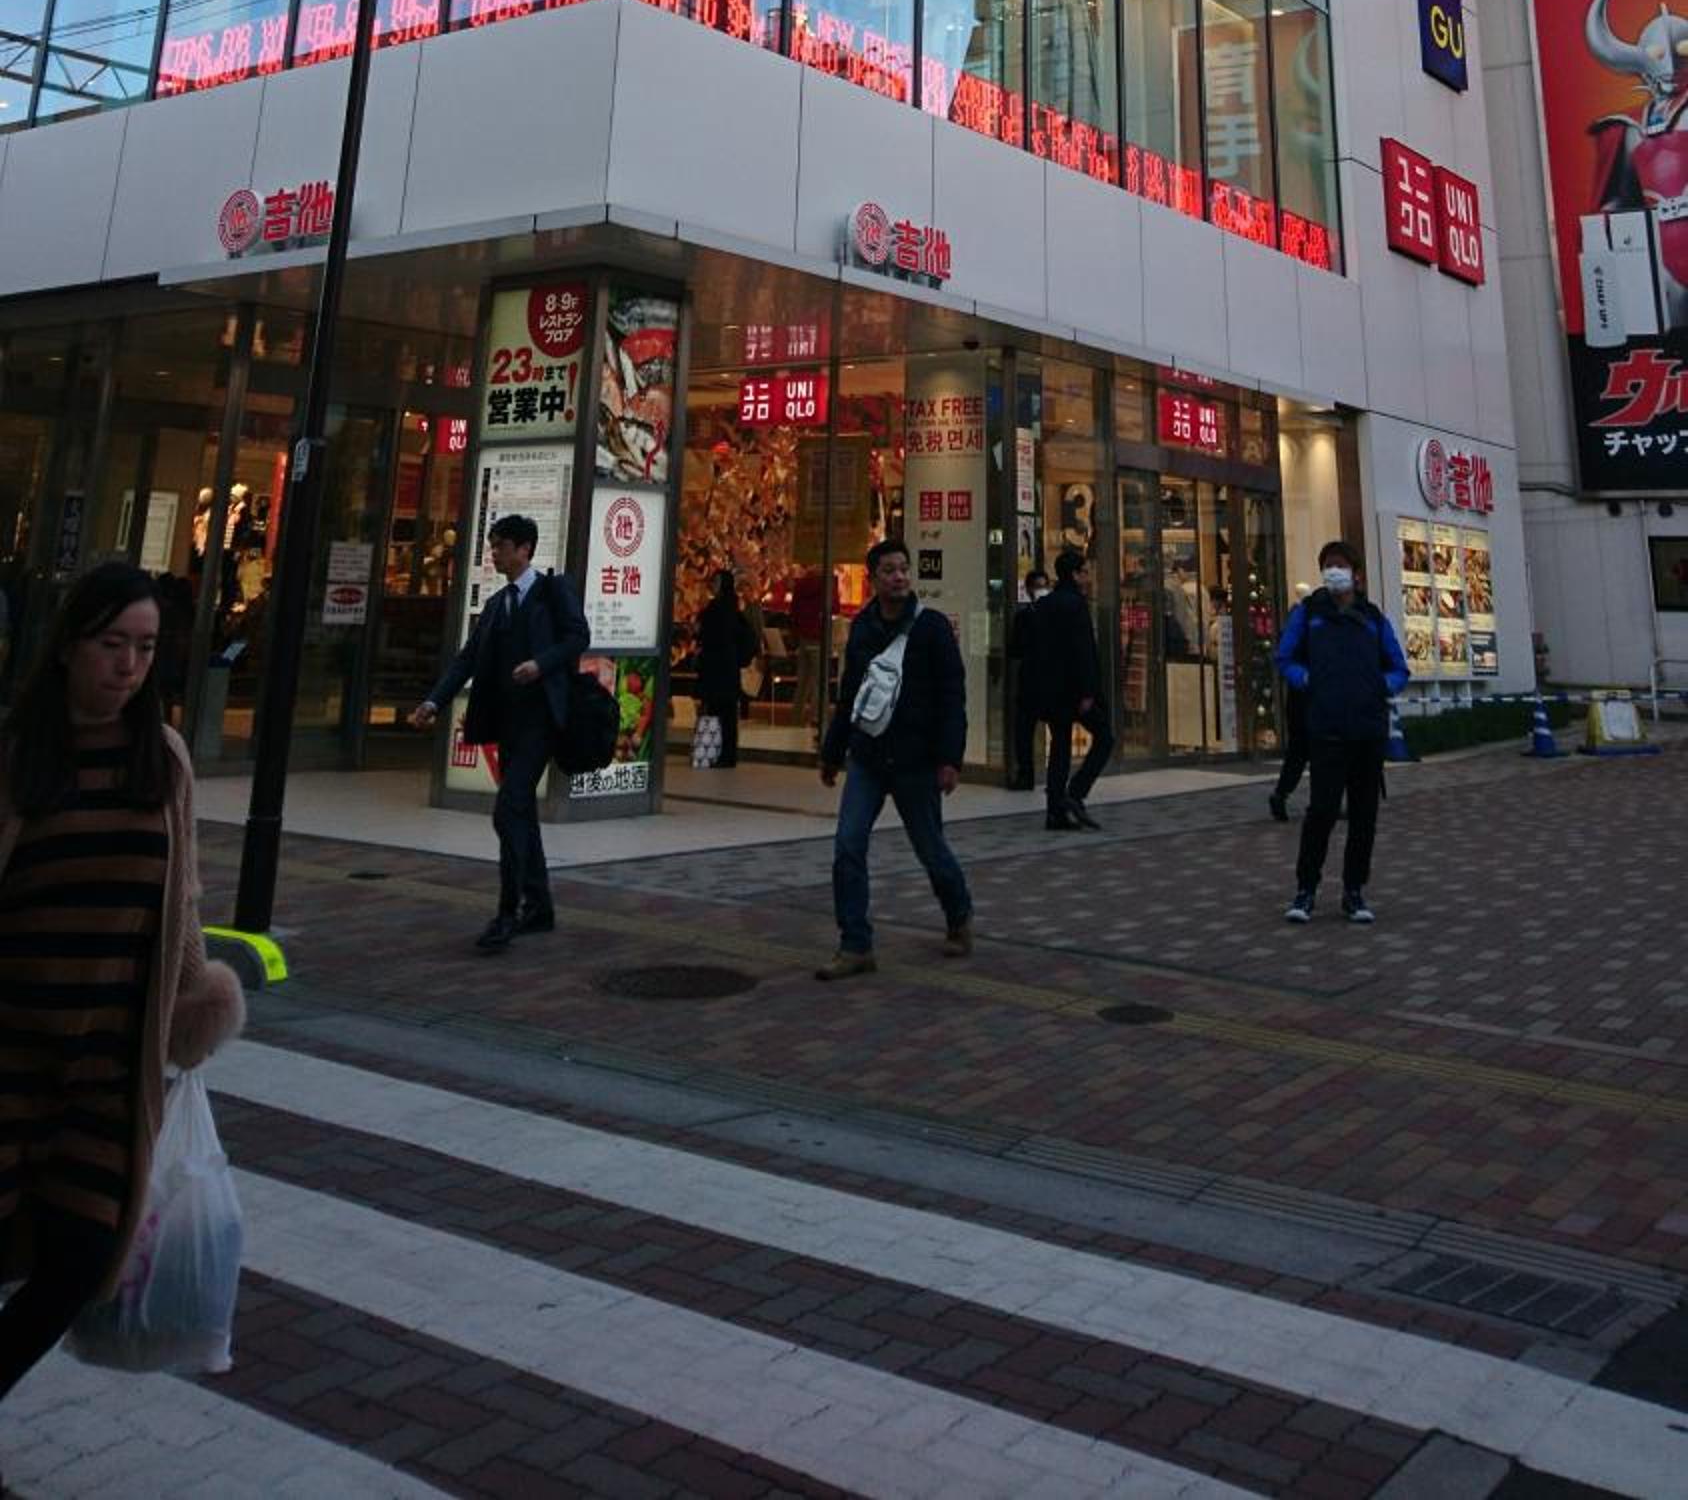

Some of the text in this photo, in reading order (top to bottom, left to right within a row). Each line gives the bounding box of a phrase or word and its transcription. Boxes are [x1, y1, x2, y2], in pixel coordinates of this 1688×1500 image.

[1430, 5, 1463, 58] GU
[1398, 157, 1429, 202] ユニ
[263, 180, 334, 241] 吉池
[1445, 182, 1474, 227] UNI
[1400, 202, 1433, 247] クロ
[895, 218, 951, 280] 吉池
[1449, 226, 1479, 268] QLO
[539, 312, 582, 330] レストラン
[544, 328, 574, 343] フロア
[490, 347, 566, 385] 23時まで
[743, 383, 769, 401] ユニ
[786, 381, 814, 399] UNI
[741, 403, 769, 420] クロ
[785, 400, 816, 420] QLO
[907, 396, 984, 417] TAX FREE
[1604, 430, 1688, 456] チャッ
[1448, 451, 1494, 514] 吉池
[919, 556, 941, 573] GU
[602, 565, 641, 595] 吉池
